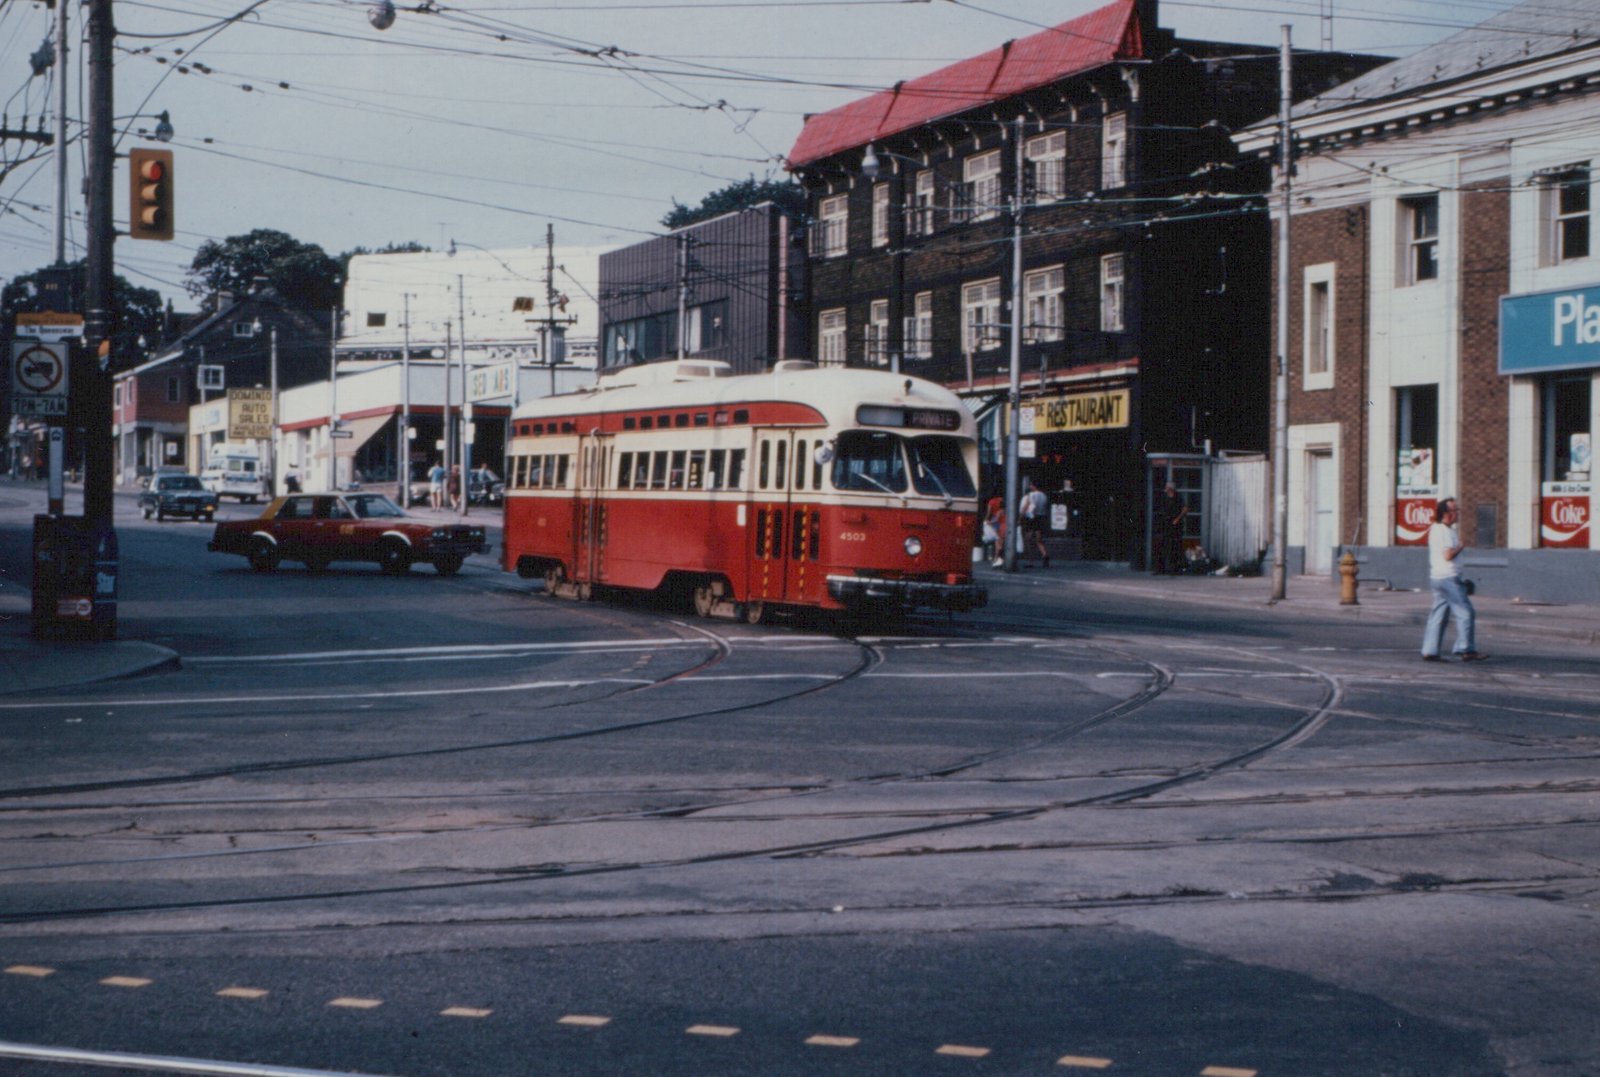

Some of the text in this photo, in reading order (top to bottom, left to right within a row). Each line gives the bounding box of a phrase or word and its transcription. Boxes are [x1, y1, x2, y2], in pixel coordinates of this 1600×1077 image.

[231, 391, 273, 401] DOMINIO
[241, 403, 267, 413] AUTO
[1046, 394, 1123, 428] RESTAURANT
[239, 414, 269, 424] SALES
[911, 412, 954, 427] PRIVATE
[1404, 502, 1435, 525] Coke
[1551, 500, 1587, 525] Coke
[839, 531, 866, 542] 4503
